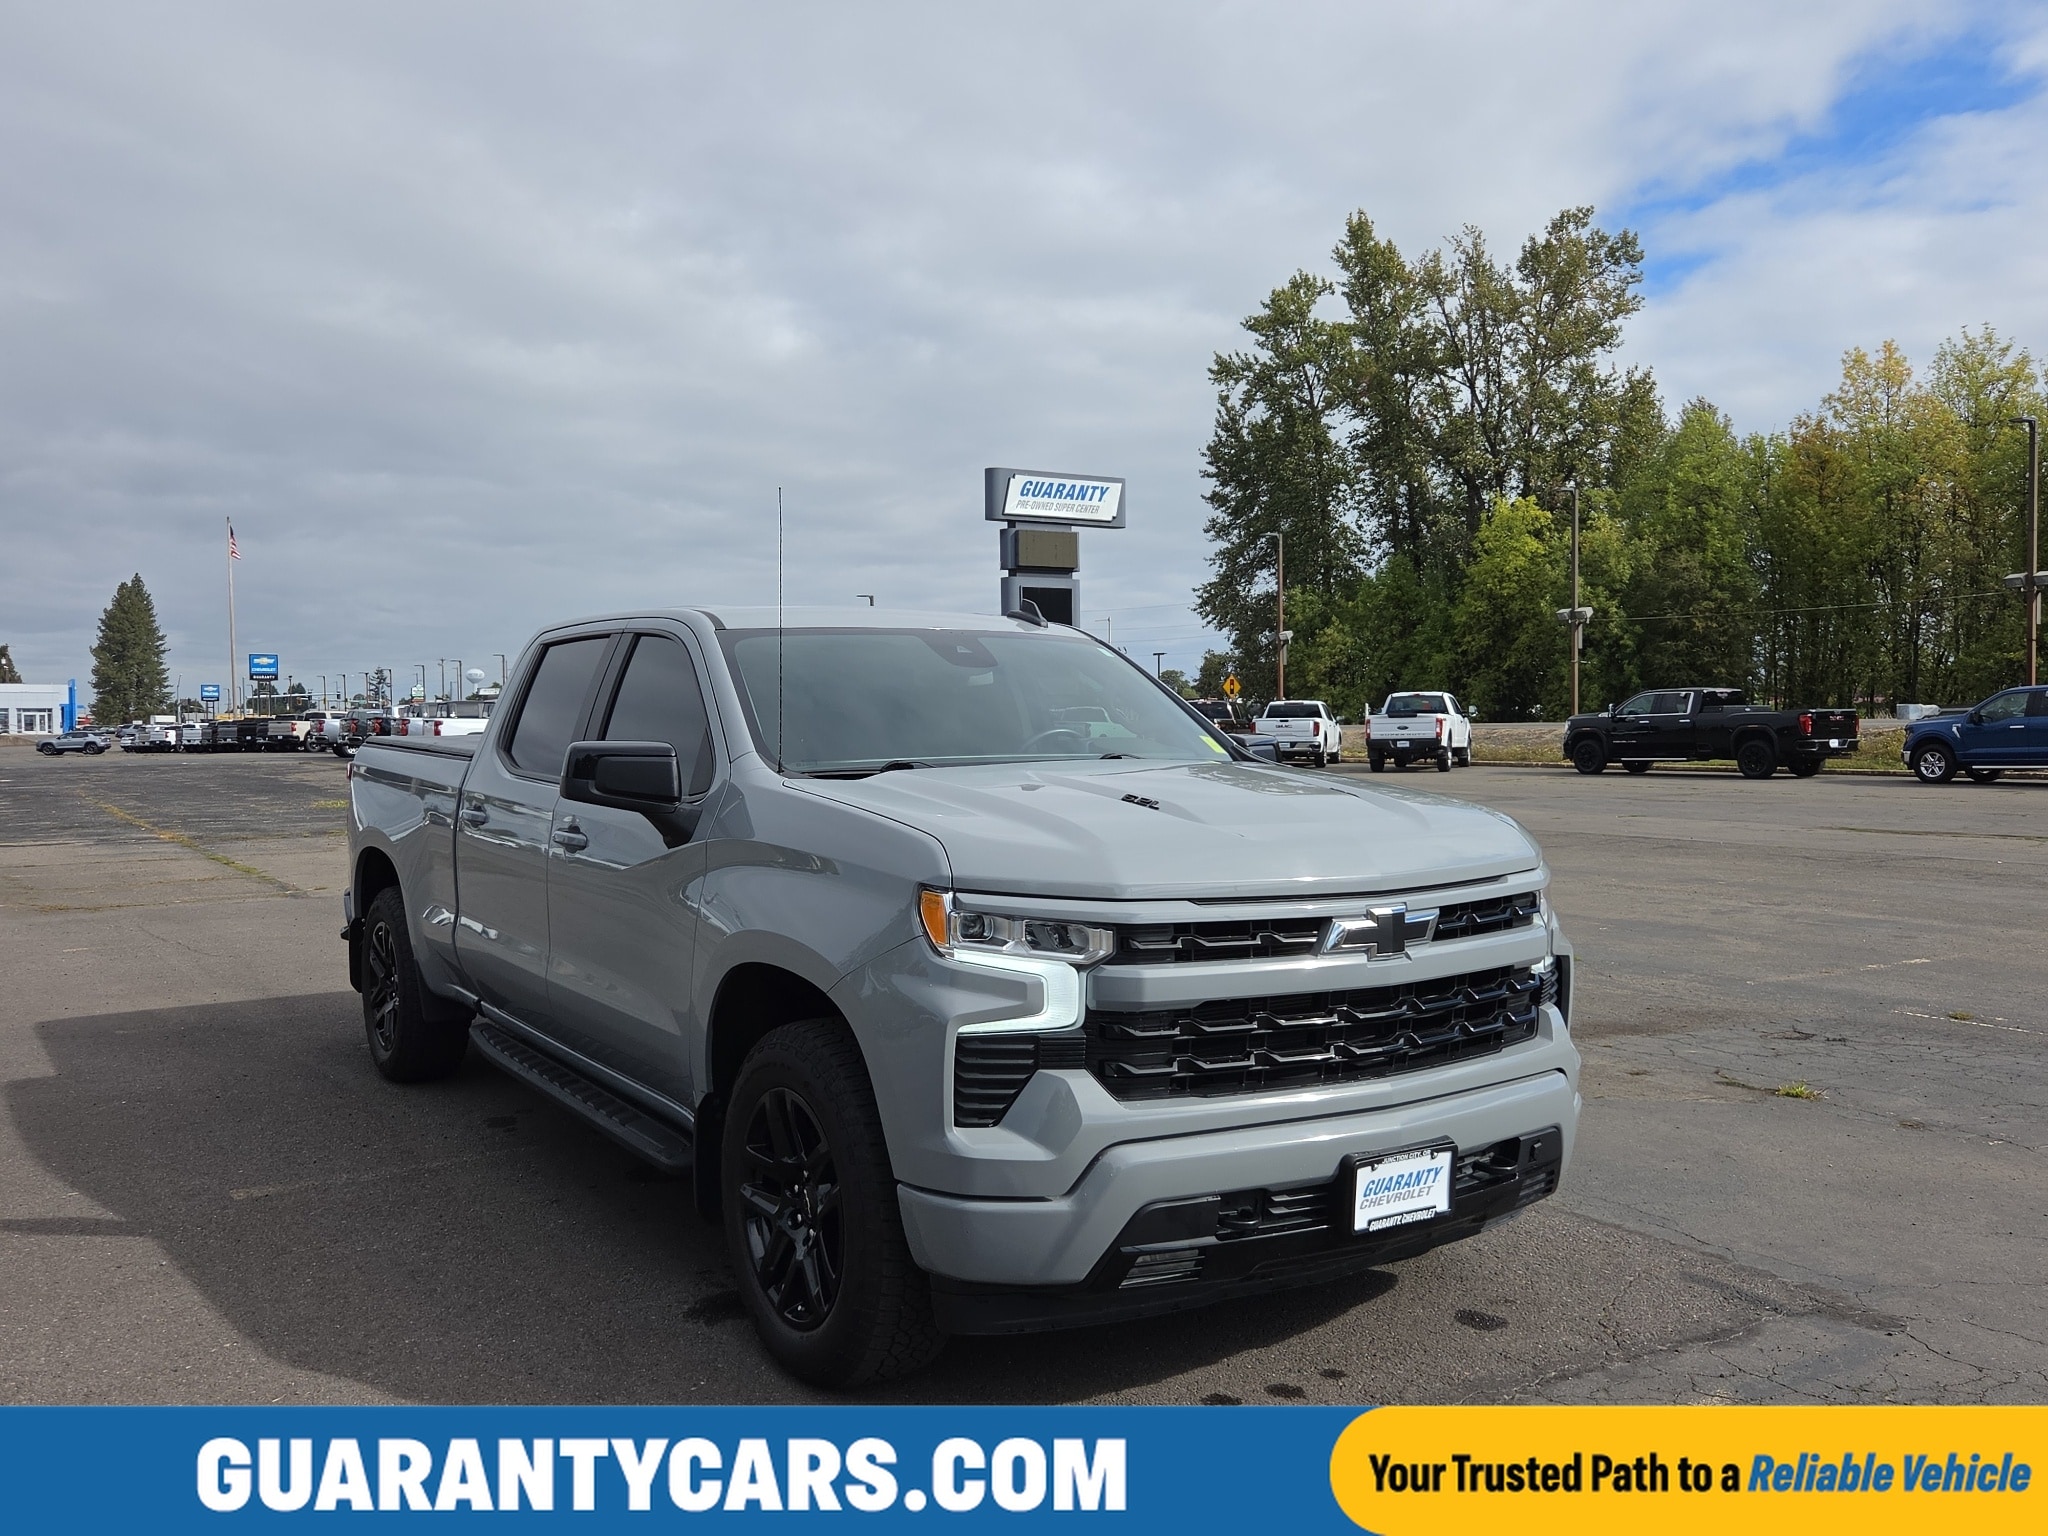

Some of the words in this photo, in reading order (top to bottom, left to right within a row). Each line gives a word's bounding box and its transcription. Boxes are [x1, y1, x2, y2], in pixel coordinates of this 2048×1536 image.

[1020, 480, 1110, 502] GUARANTY
[1015, 499, 1054, 511] PRE-OWNED
[1054, 502, 1075, 513] SUPER
[1075, 503, 1100, 514] CENTER
[1382, 1154, 1409, 1164] JUNCTION
[1363, 1165, 1443, 1198] GUARANTY
[1360, 1185, 1434, 1210] CHEVROLET
[1402, 1208, 1436, 1224] CHEVROLET
